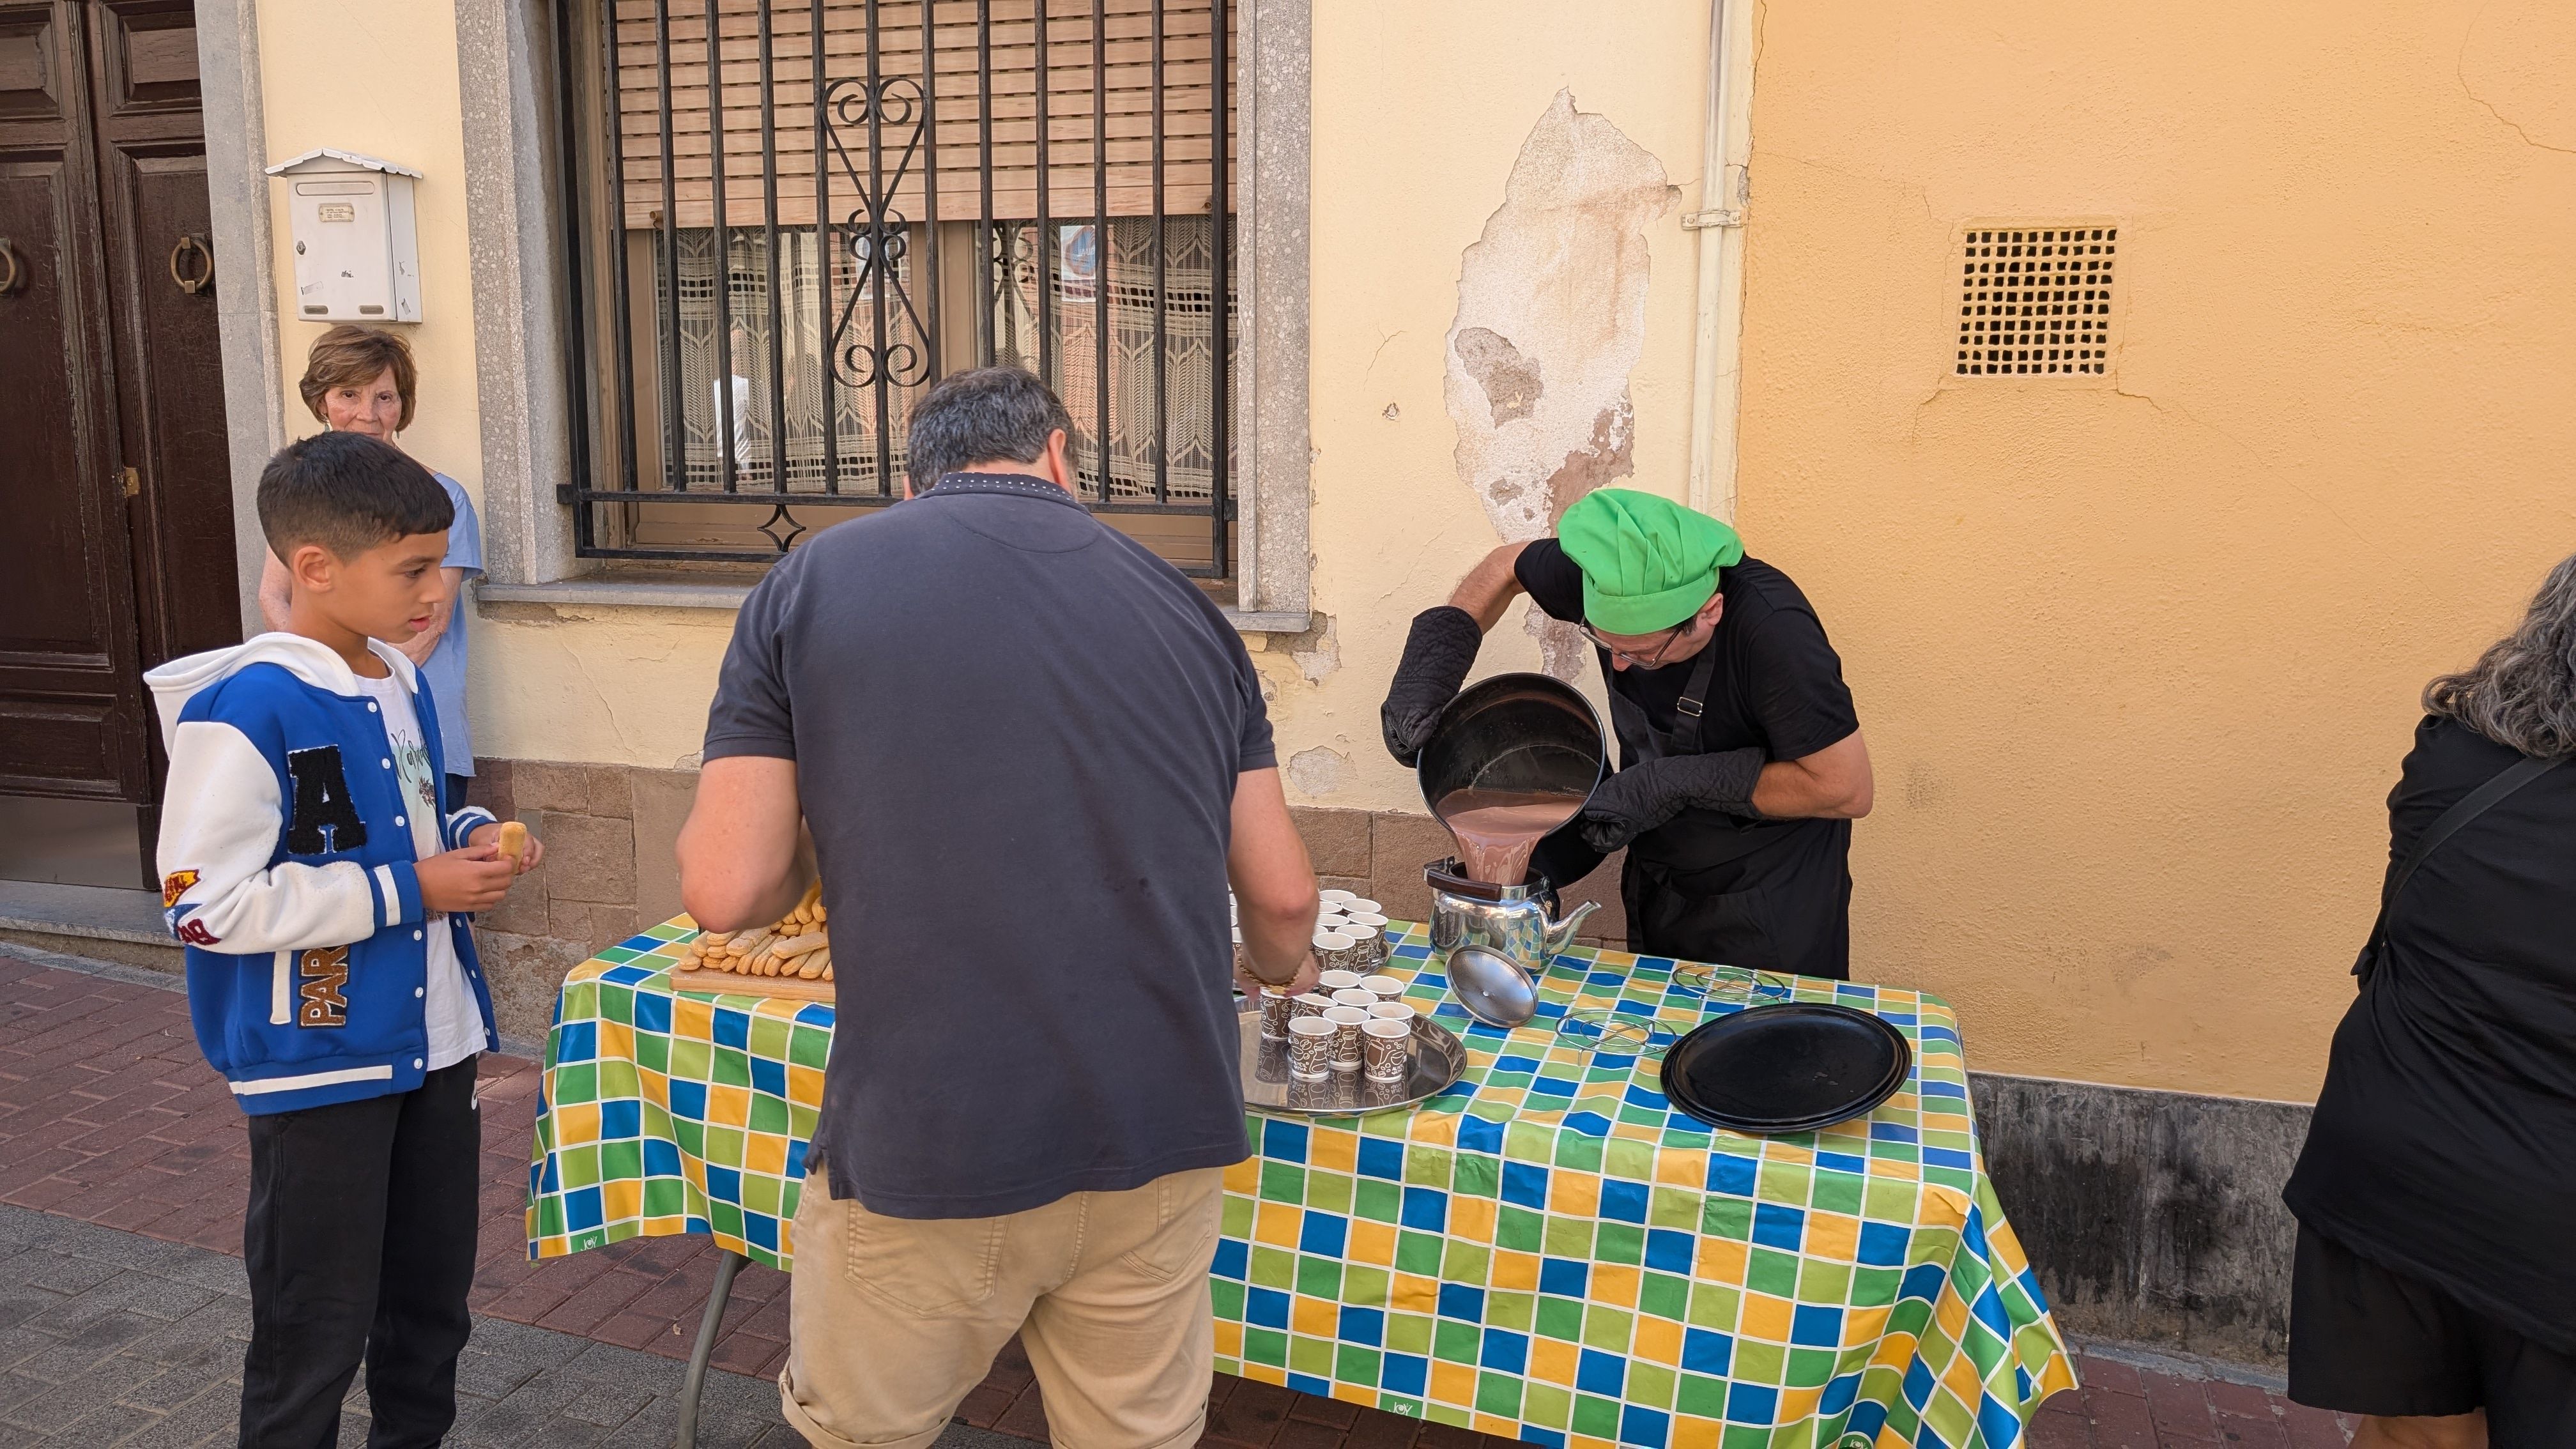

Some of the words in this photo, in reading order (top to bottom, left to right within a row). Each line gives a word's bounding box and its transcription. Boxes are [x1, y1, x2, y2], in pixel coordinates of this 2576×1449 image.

[288, 744, 367, 854] A
[580, 1236, 598, 1252] JOY
[1388, 1401, 1413, 1416] JOY
